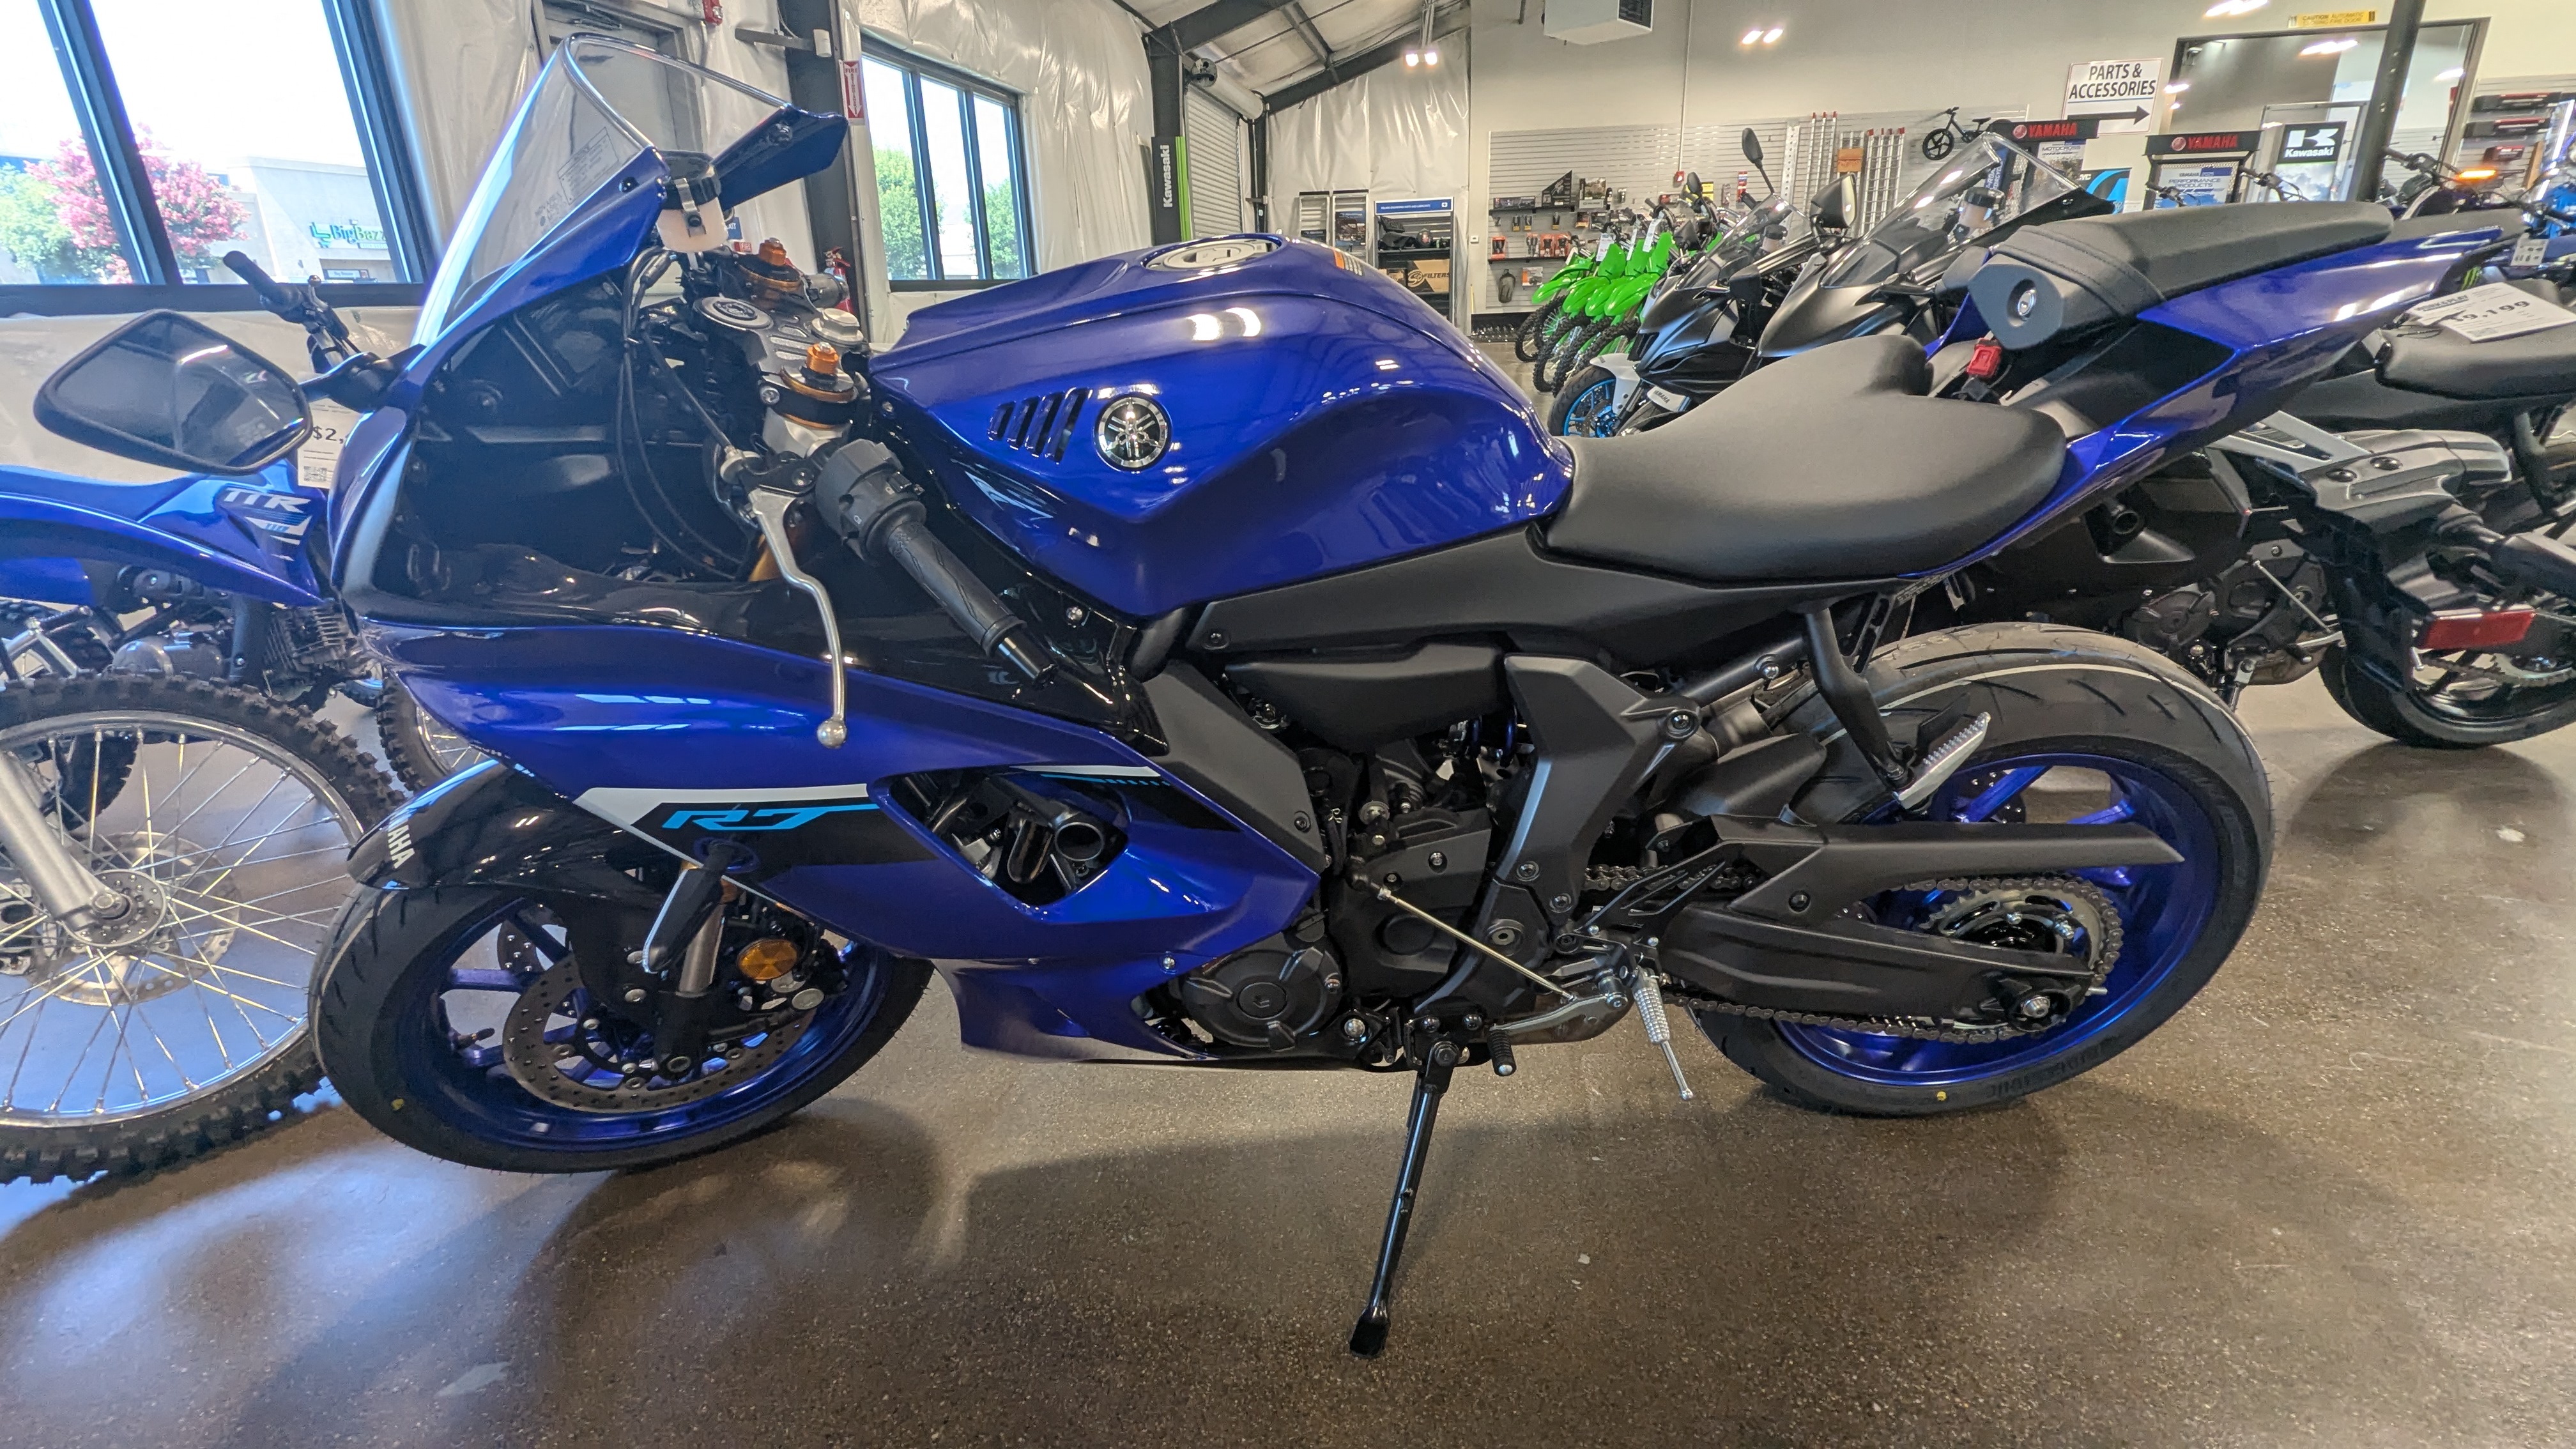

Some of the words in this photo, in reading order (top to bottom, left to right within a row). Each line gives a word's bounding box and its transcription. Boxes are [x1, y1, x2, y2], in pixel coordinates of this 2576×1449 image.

[2089, 63, 2130, 80] PARTS
[2131, 63, 2142, 78] &
[2068, 79, 2156, 100] ACCESSORIES
[2028, 123, 2077, 138] YAMAHA
[2188, 134, 2238, 150] YAMAHA
[2284, 146, 2335, 158] Kawasaki
[1160, 144, 1173, 208] Kawasaki
[661, 804, 880, 831] R7
